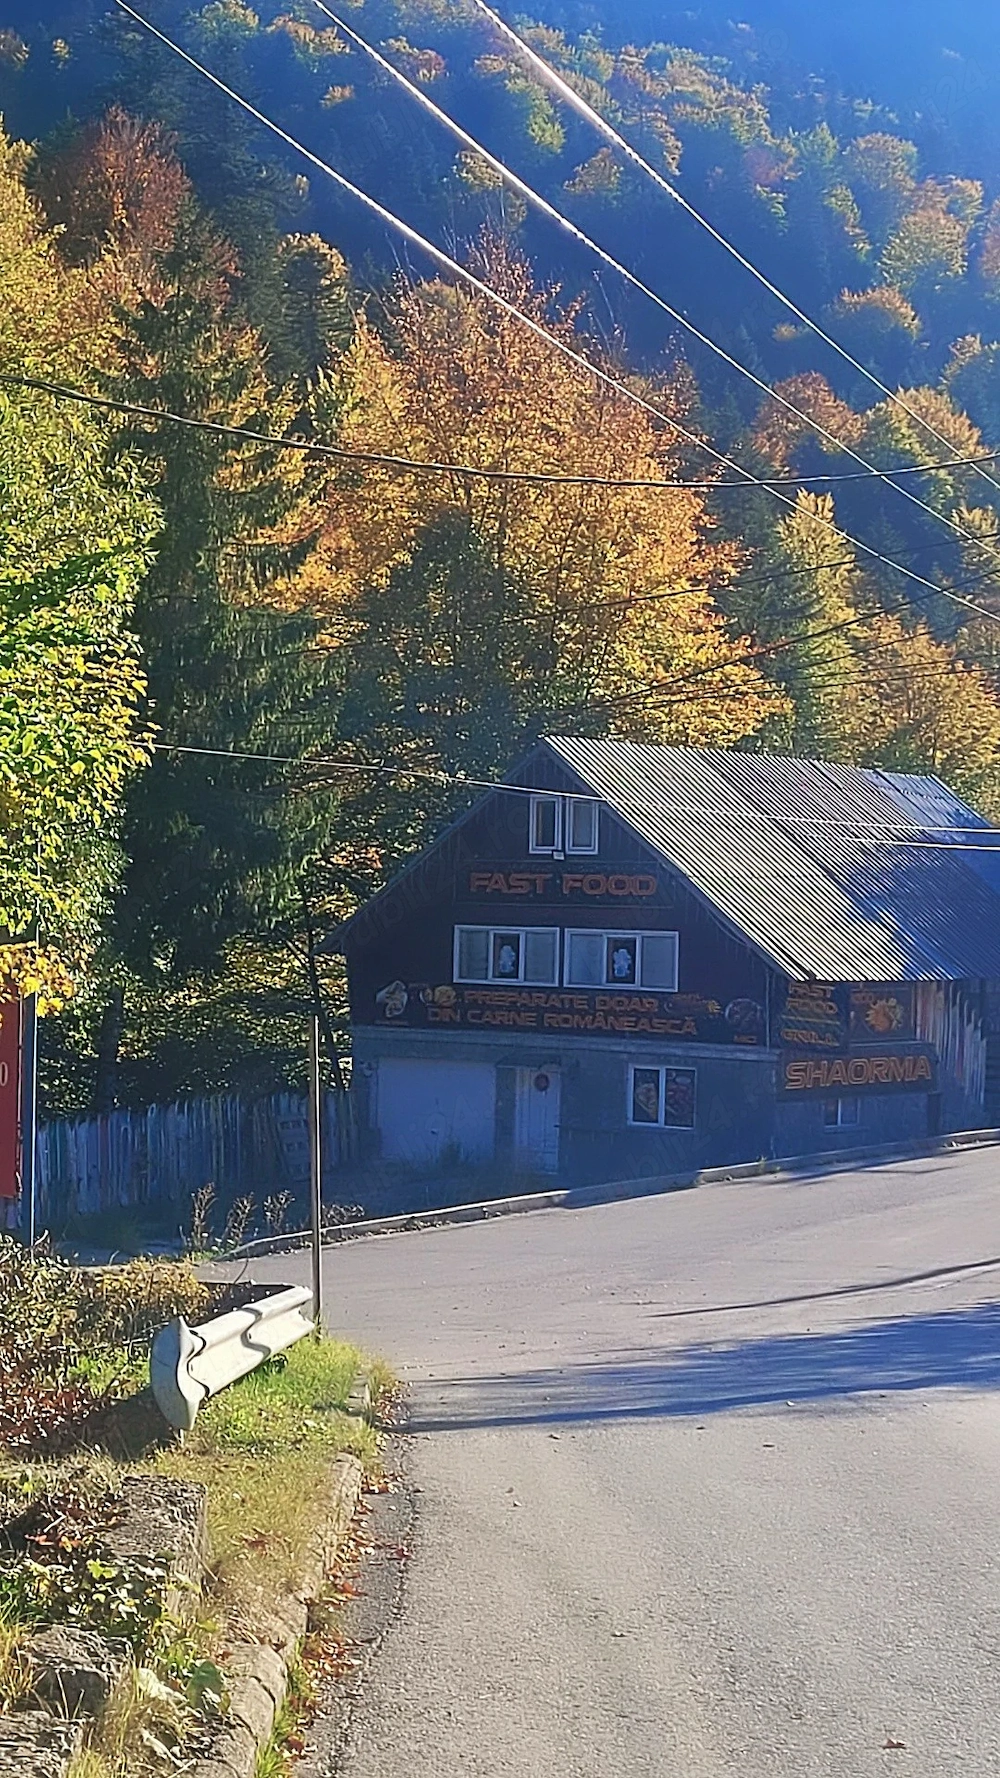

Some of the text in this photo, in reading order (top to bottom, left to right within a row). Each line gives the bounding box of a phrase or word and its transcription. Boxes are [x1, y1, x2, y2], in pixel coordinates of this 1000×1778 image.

[469, 872, 658, 897] FAST FOOD
[463, 989, 589, 1010] PREPARATE
[595, 994, 660, 1013] DOAR
[788, 982, 836, 999] FAST
[786, 997, 839, 1015] FOOD
[427, 1007, 698, 1035] DIN CARNE ROMÂNEASCĂ
[784, 1055, 932, 1090] SHAORMA
